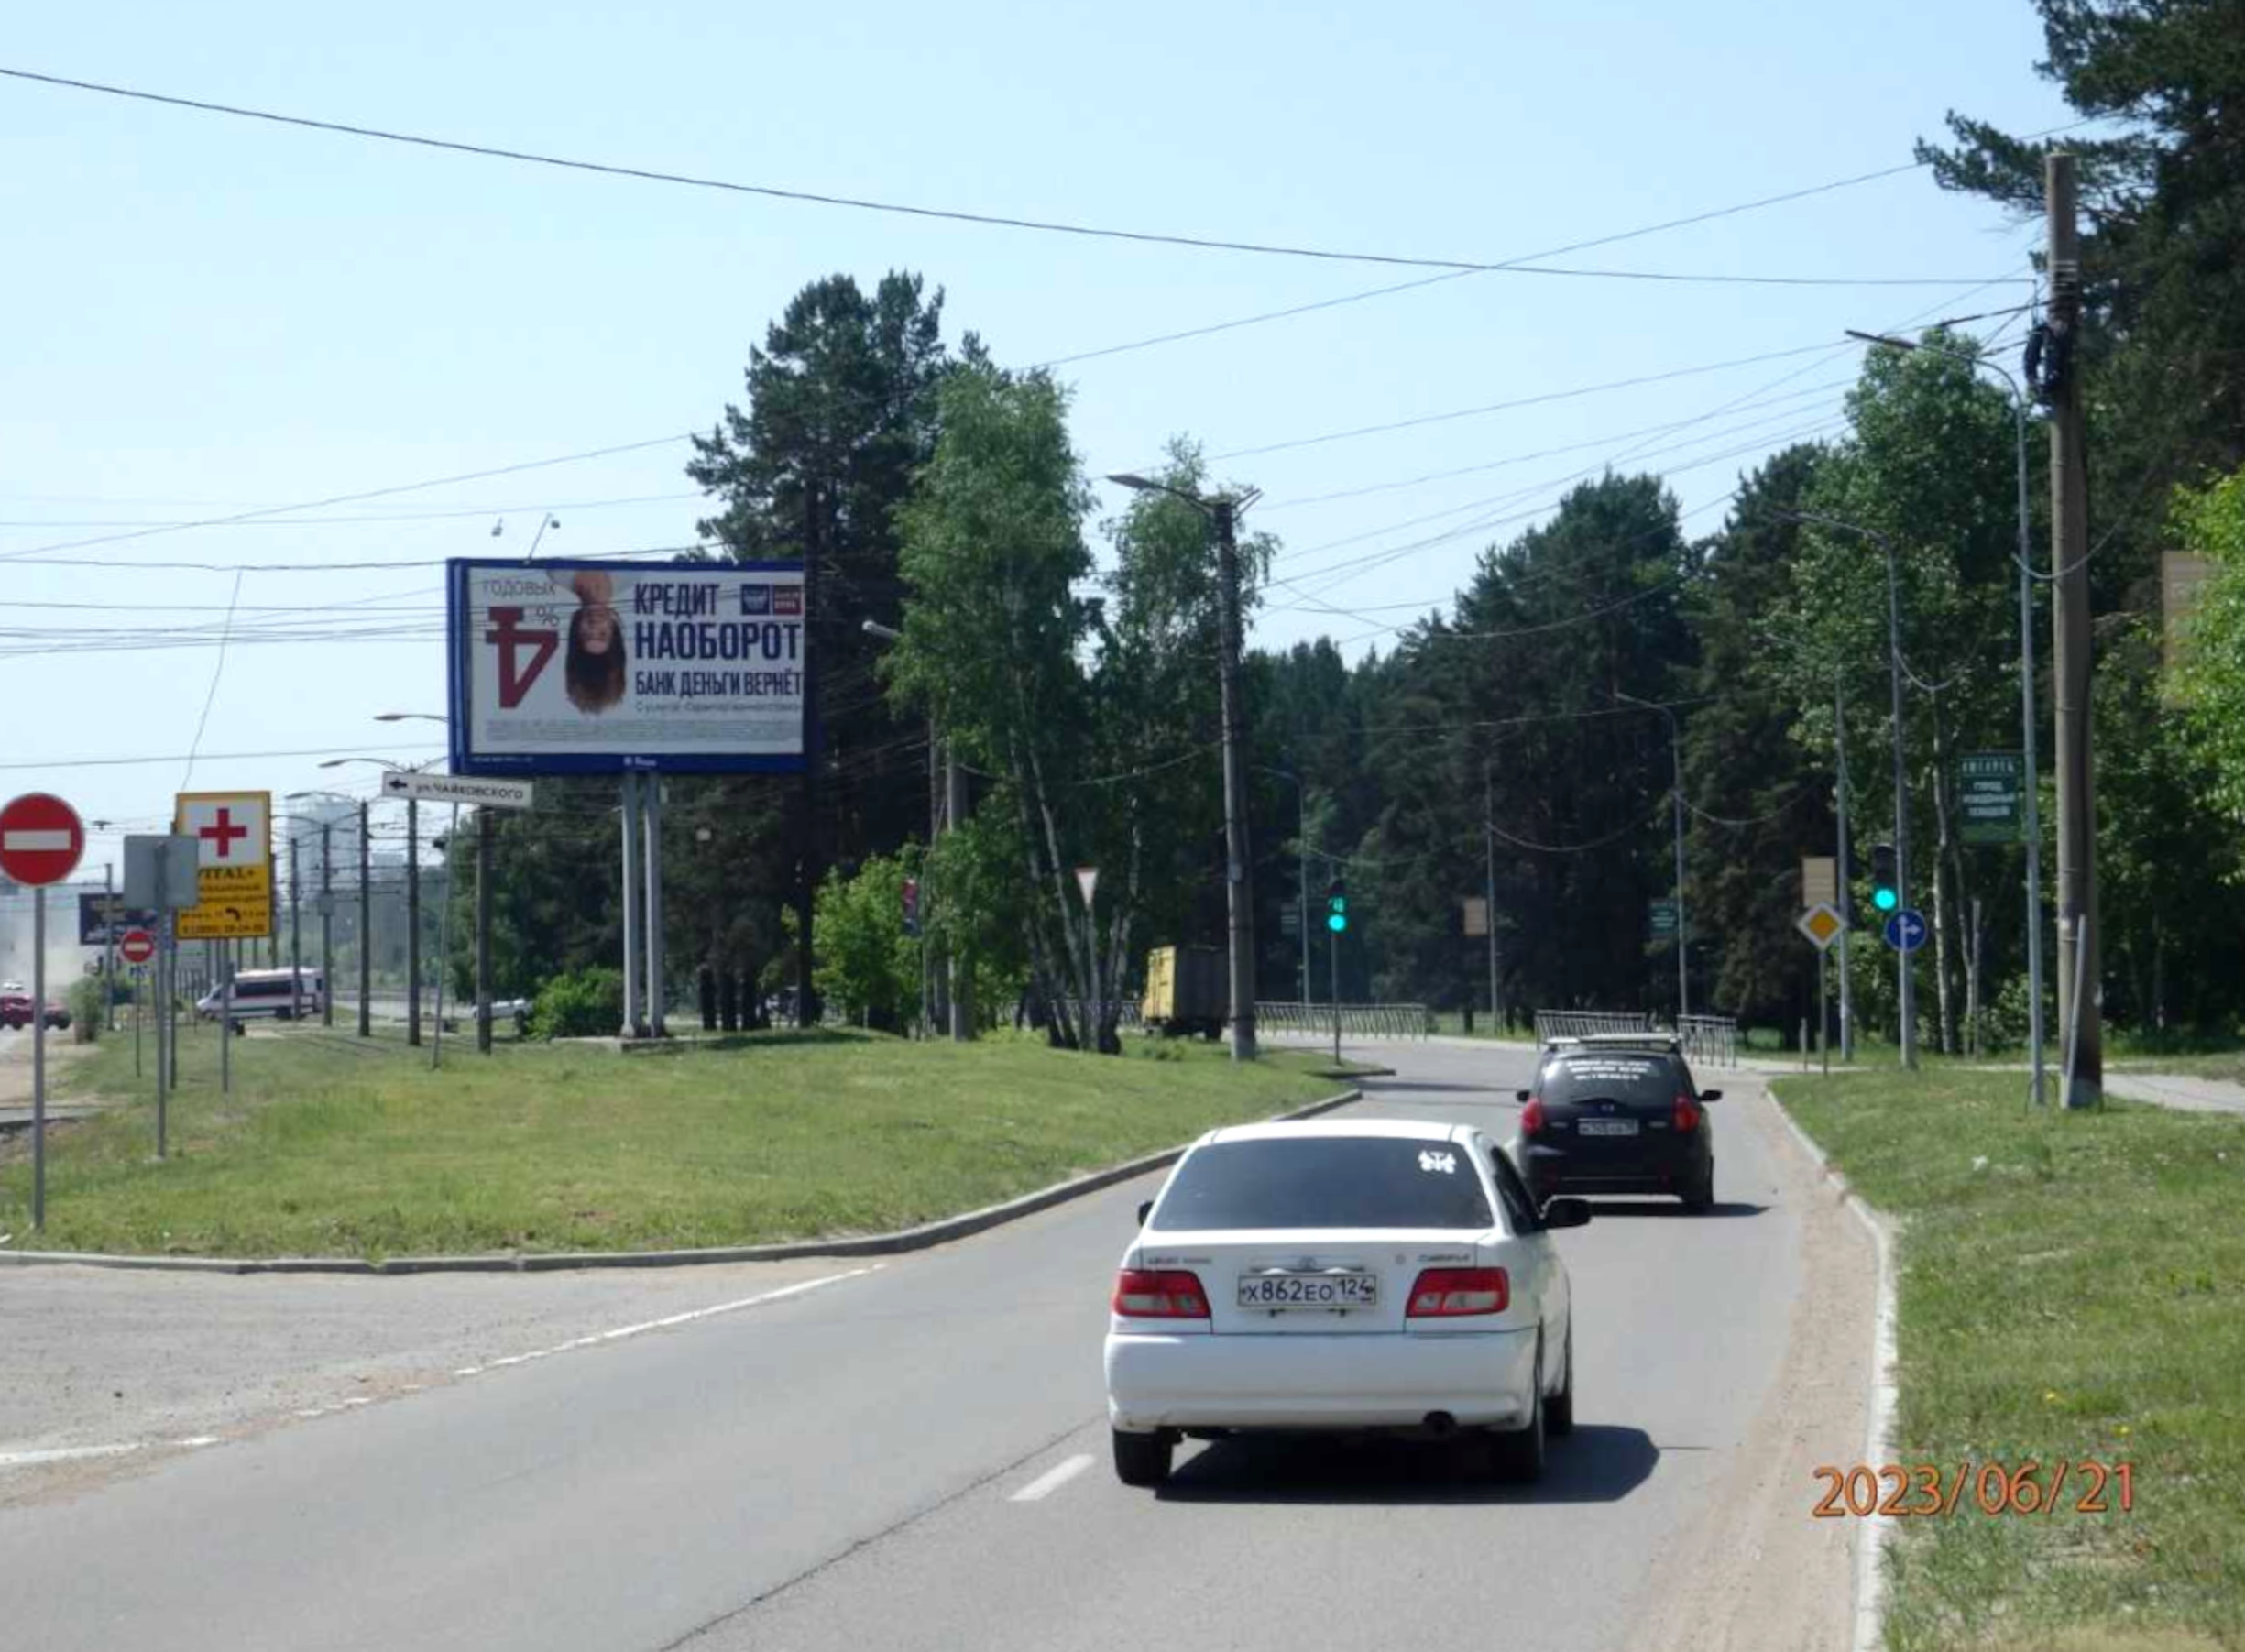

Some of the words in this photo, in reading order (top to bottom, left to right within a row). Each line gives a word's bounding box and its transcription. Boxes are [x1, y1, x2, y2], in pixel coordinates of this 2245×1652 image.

[634, 583, 719, 619] КРЕДИТ
[634, 621, 802, 660] НАОБОРОТ
[635, 672, 677, 696] БАНК
[679, 672, 740, 698] ДЕНЬГИ
[1245, 1280, 1333, 1302] Х862ЕО
